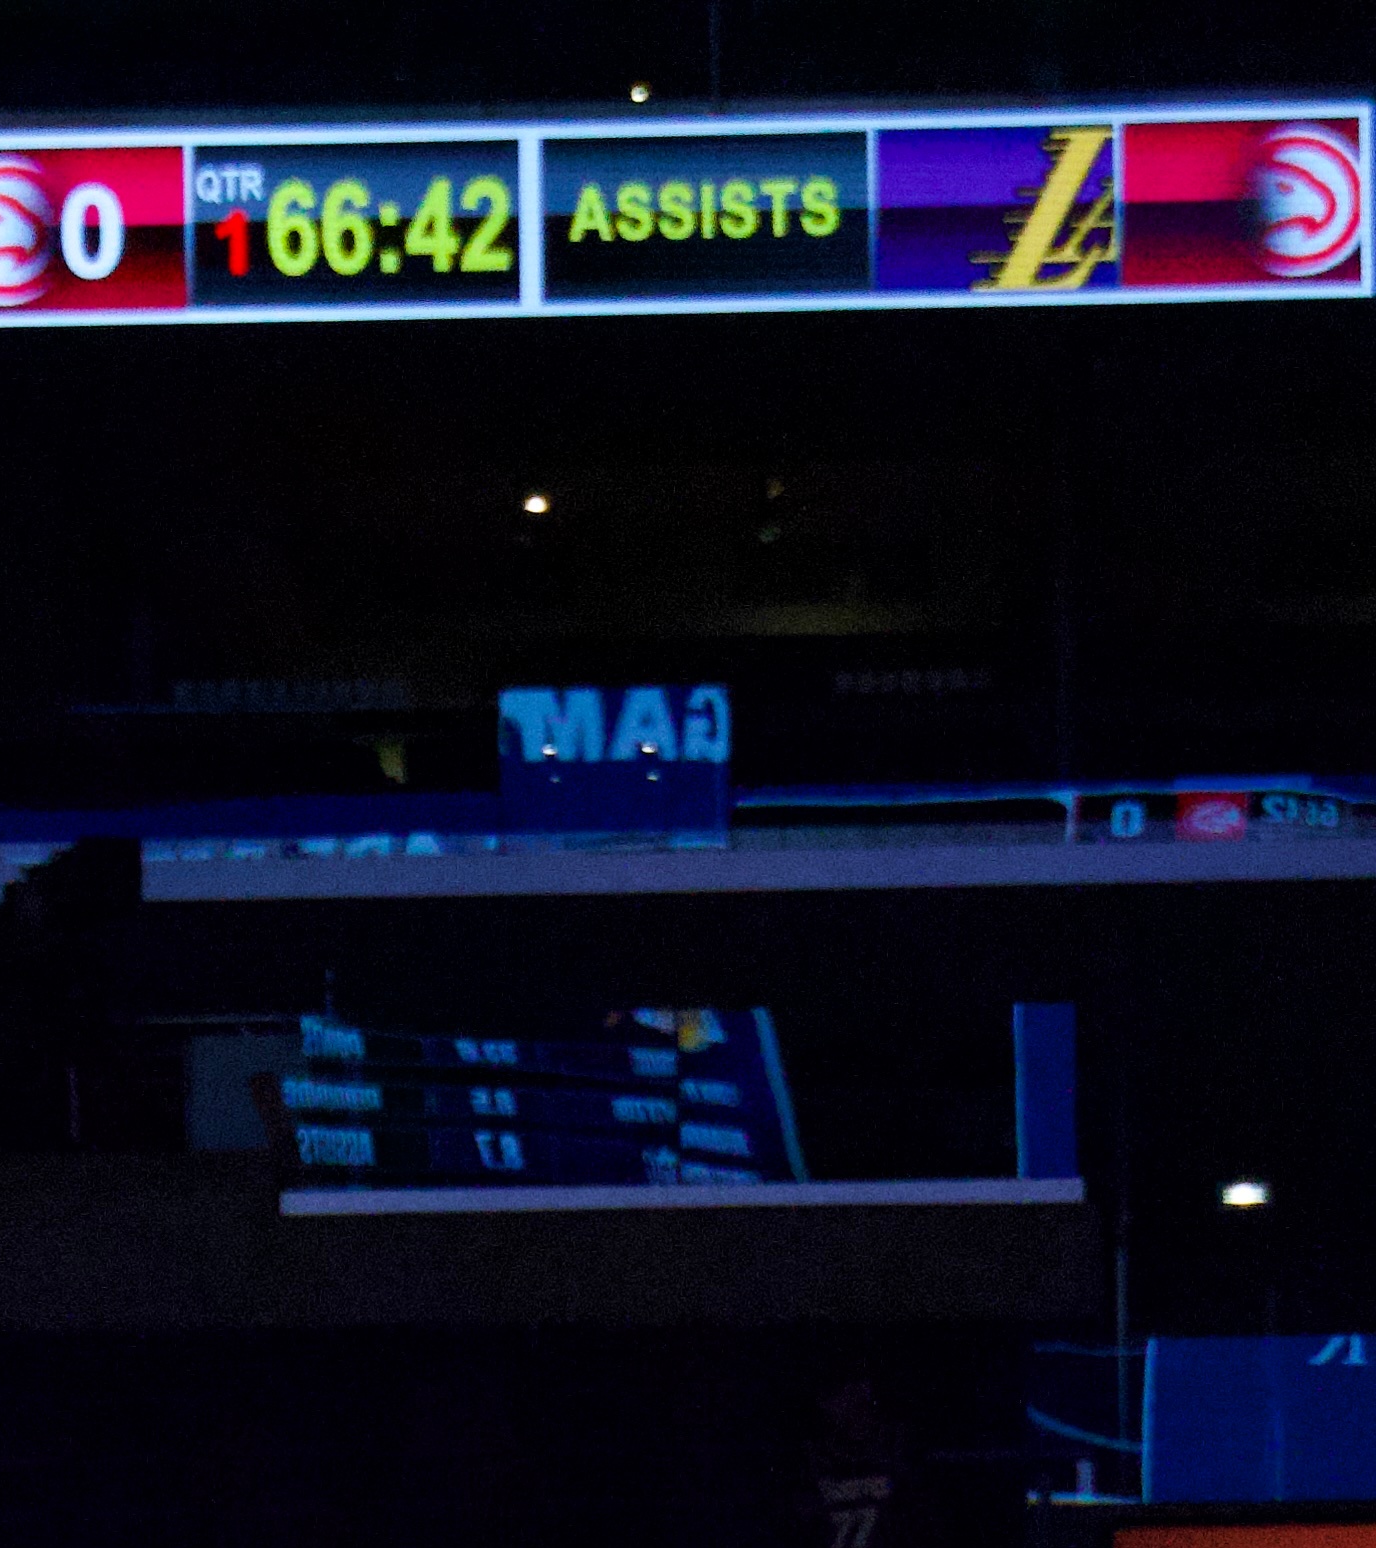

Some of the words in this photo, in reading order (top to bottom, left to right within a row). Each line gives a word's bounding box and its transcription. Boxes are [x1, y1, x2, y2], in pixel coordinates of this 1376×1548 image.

[195, 163, 264, 205] QTR
[568, 177, 841, 242] ASSISTS
[60, 181, 126, 280] 0
[216, 211, 249, 278] 1
[266, 175, 512, 278] 66:42
